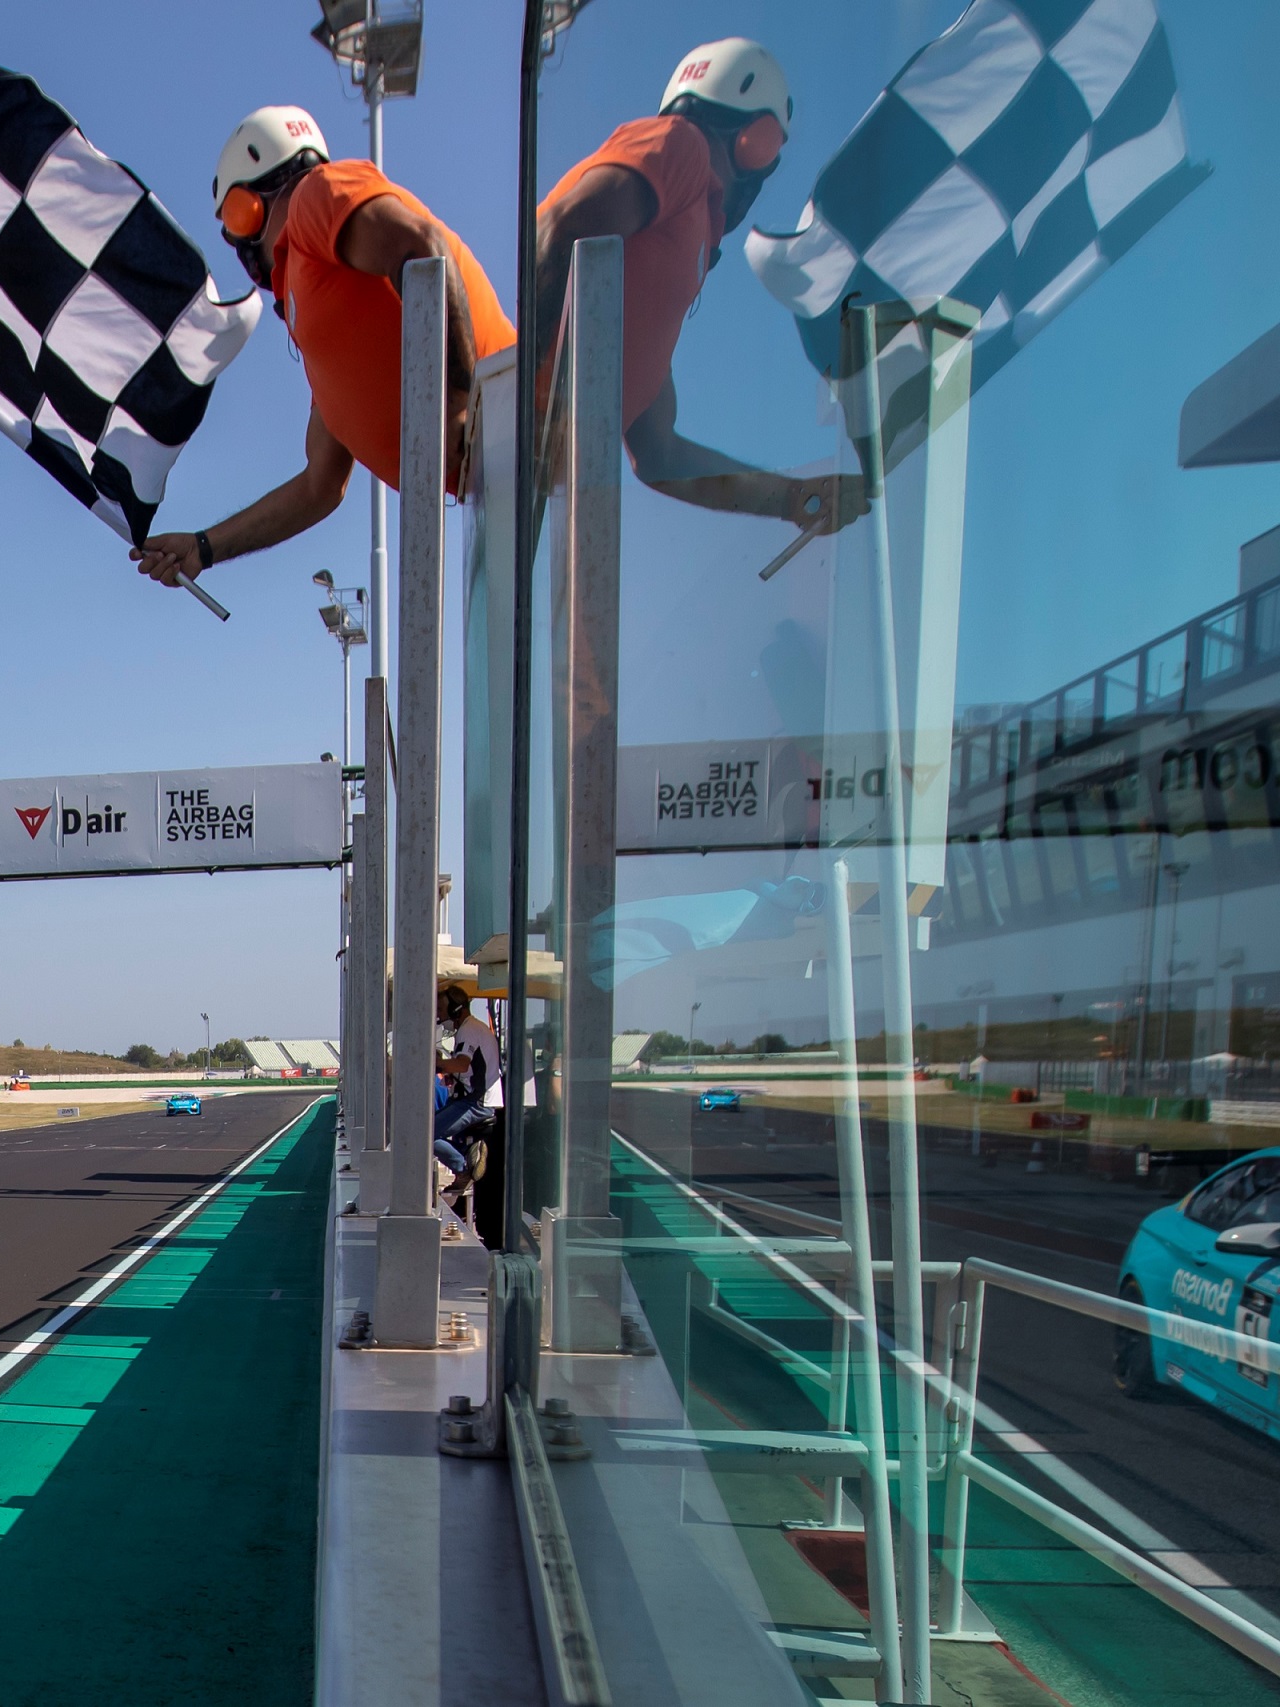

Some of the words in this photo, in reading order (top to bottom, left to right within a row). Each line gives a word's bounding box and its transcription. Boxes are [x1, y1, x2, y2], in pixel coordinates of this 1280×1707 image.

[166, 789, 209, 807] THE
[166, 804, 254, 825] AIRBAG
[167, 822, 253, 842] SYSTEM
